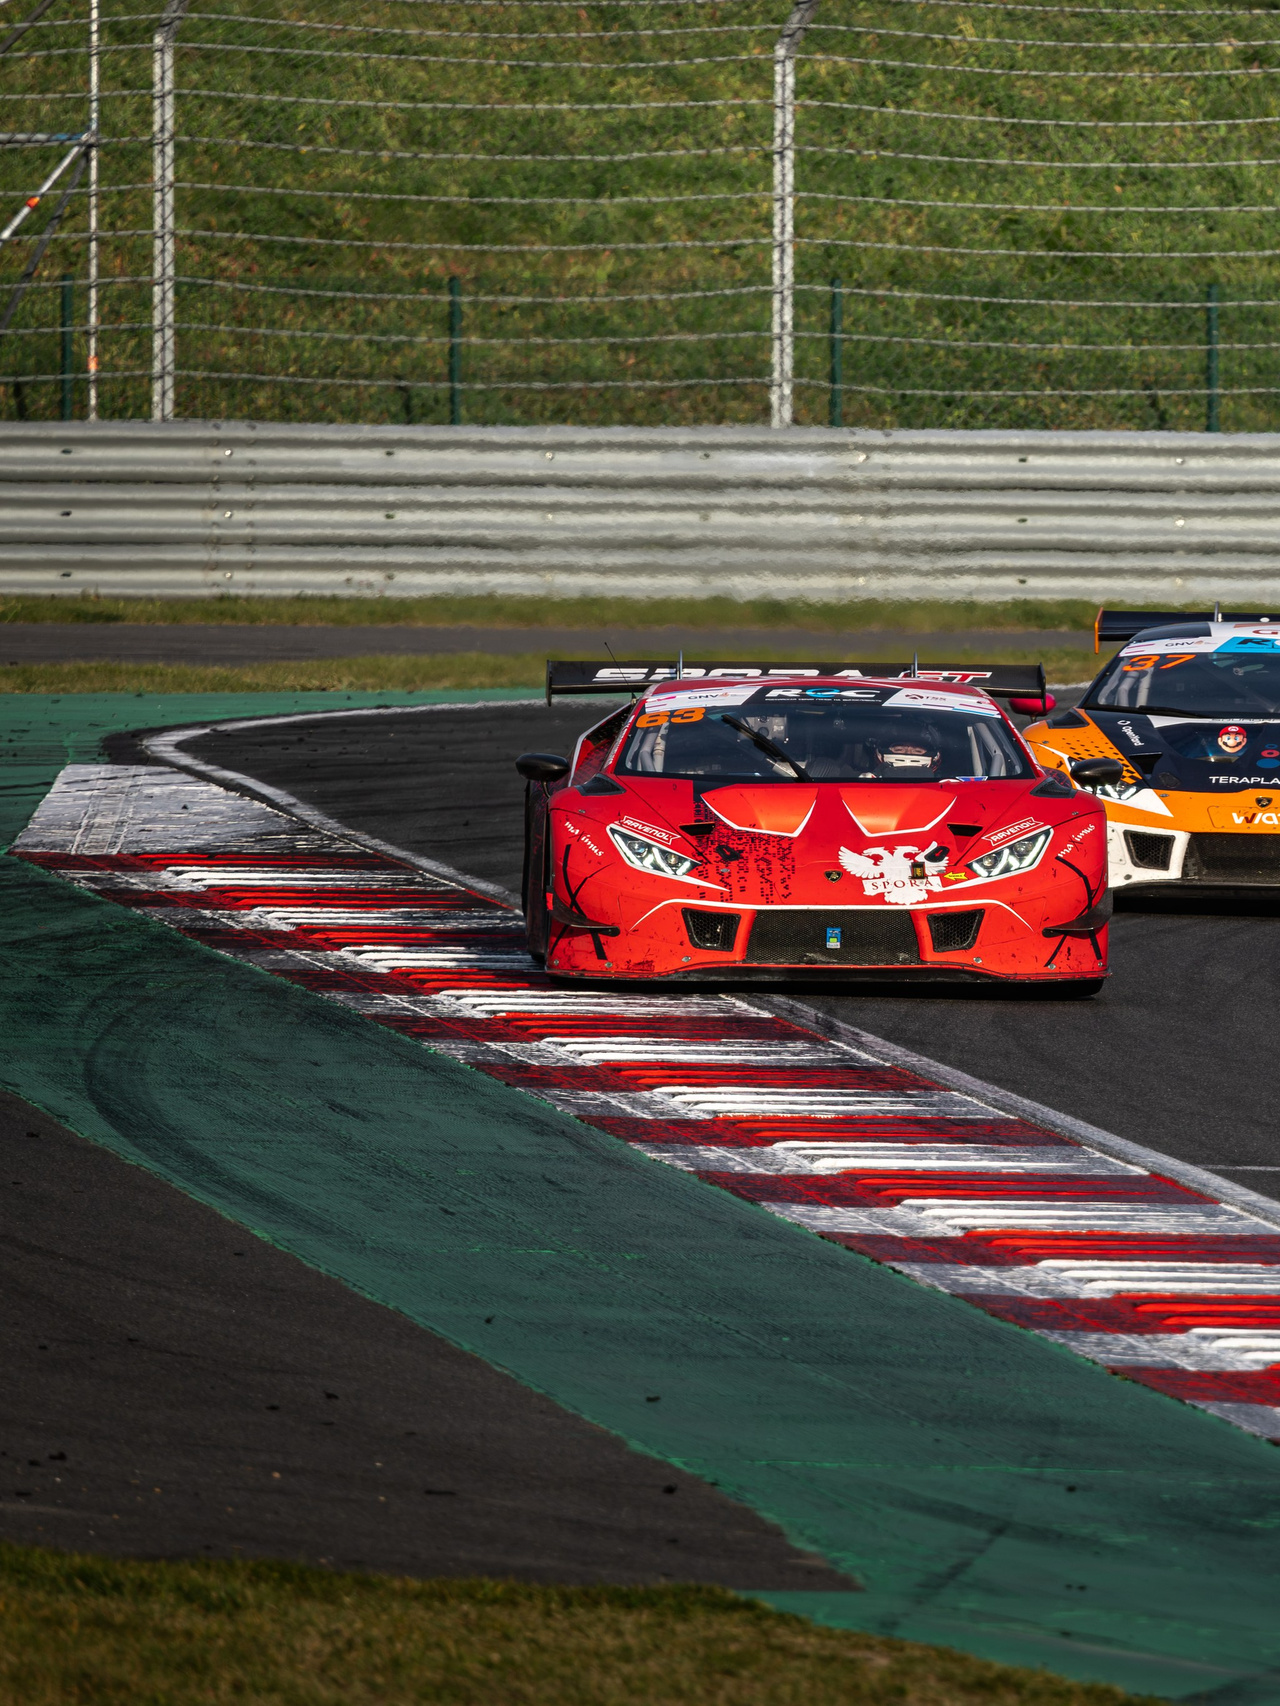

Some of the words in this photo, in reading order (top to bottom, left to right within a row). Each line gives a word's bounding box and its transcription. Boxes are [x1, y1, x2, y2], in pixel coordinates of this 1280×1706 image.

[1122, 654, 1197, 672] 37
[635, 707, 706, 728] 63
[624, 818, 673, 842] RAVENOL
[990, 819, 1036, 843] RAVENOL
